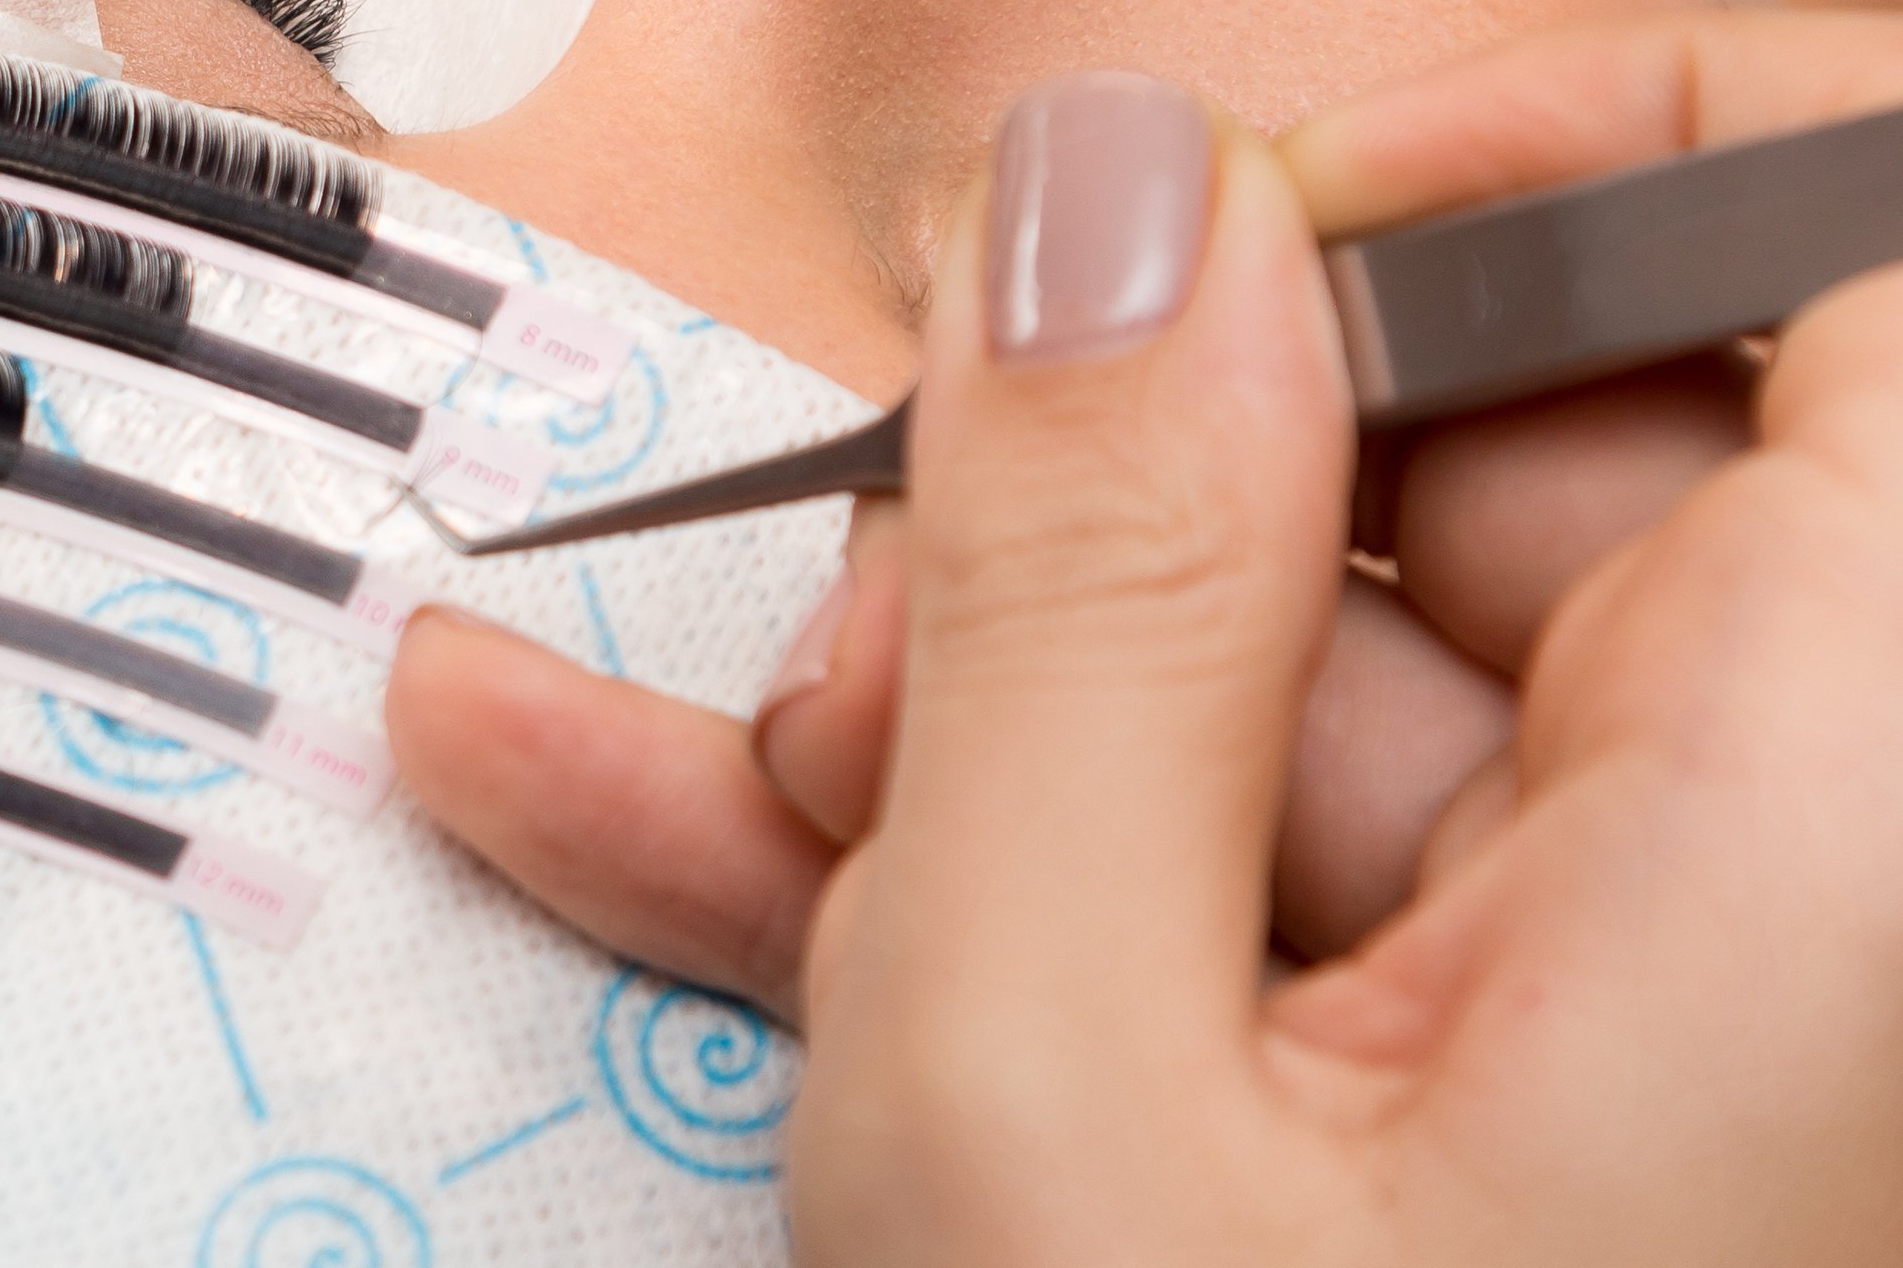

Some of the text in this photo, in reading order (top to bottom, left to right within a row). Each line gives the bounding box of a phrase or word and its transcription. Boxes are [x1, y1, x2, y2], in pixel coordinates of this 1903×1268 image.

[519, 323, 600, 374] 8 mm
[464, 459, 520, 495] mm
[352, 593, 391, 626] 10
[271, 726, 368, 787] 11 mm
[224, 874, 285, 916] mm
